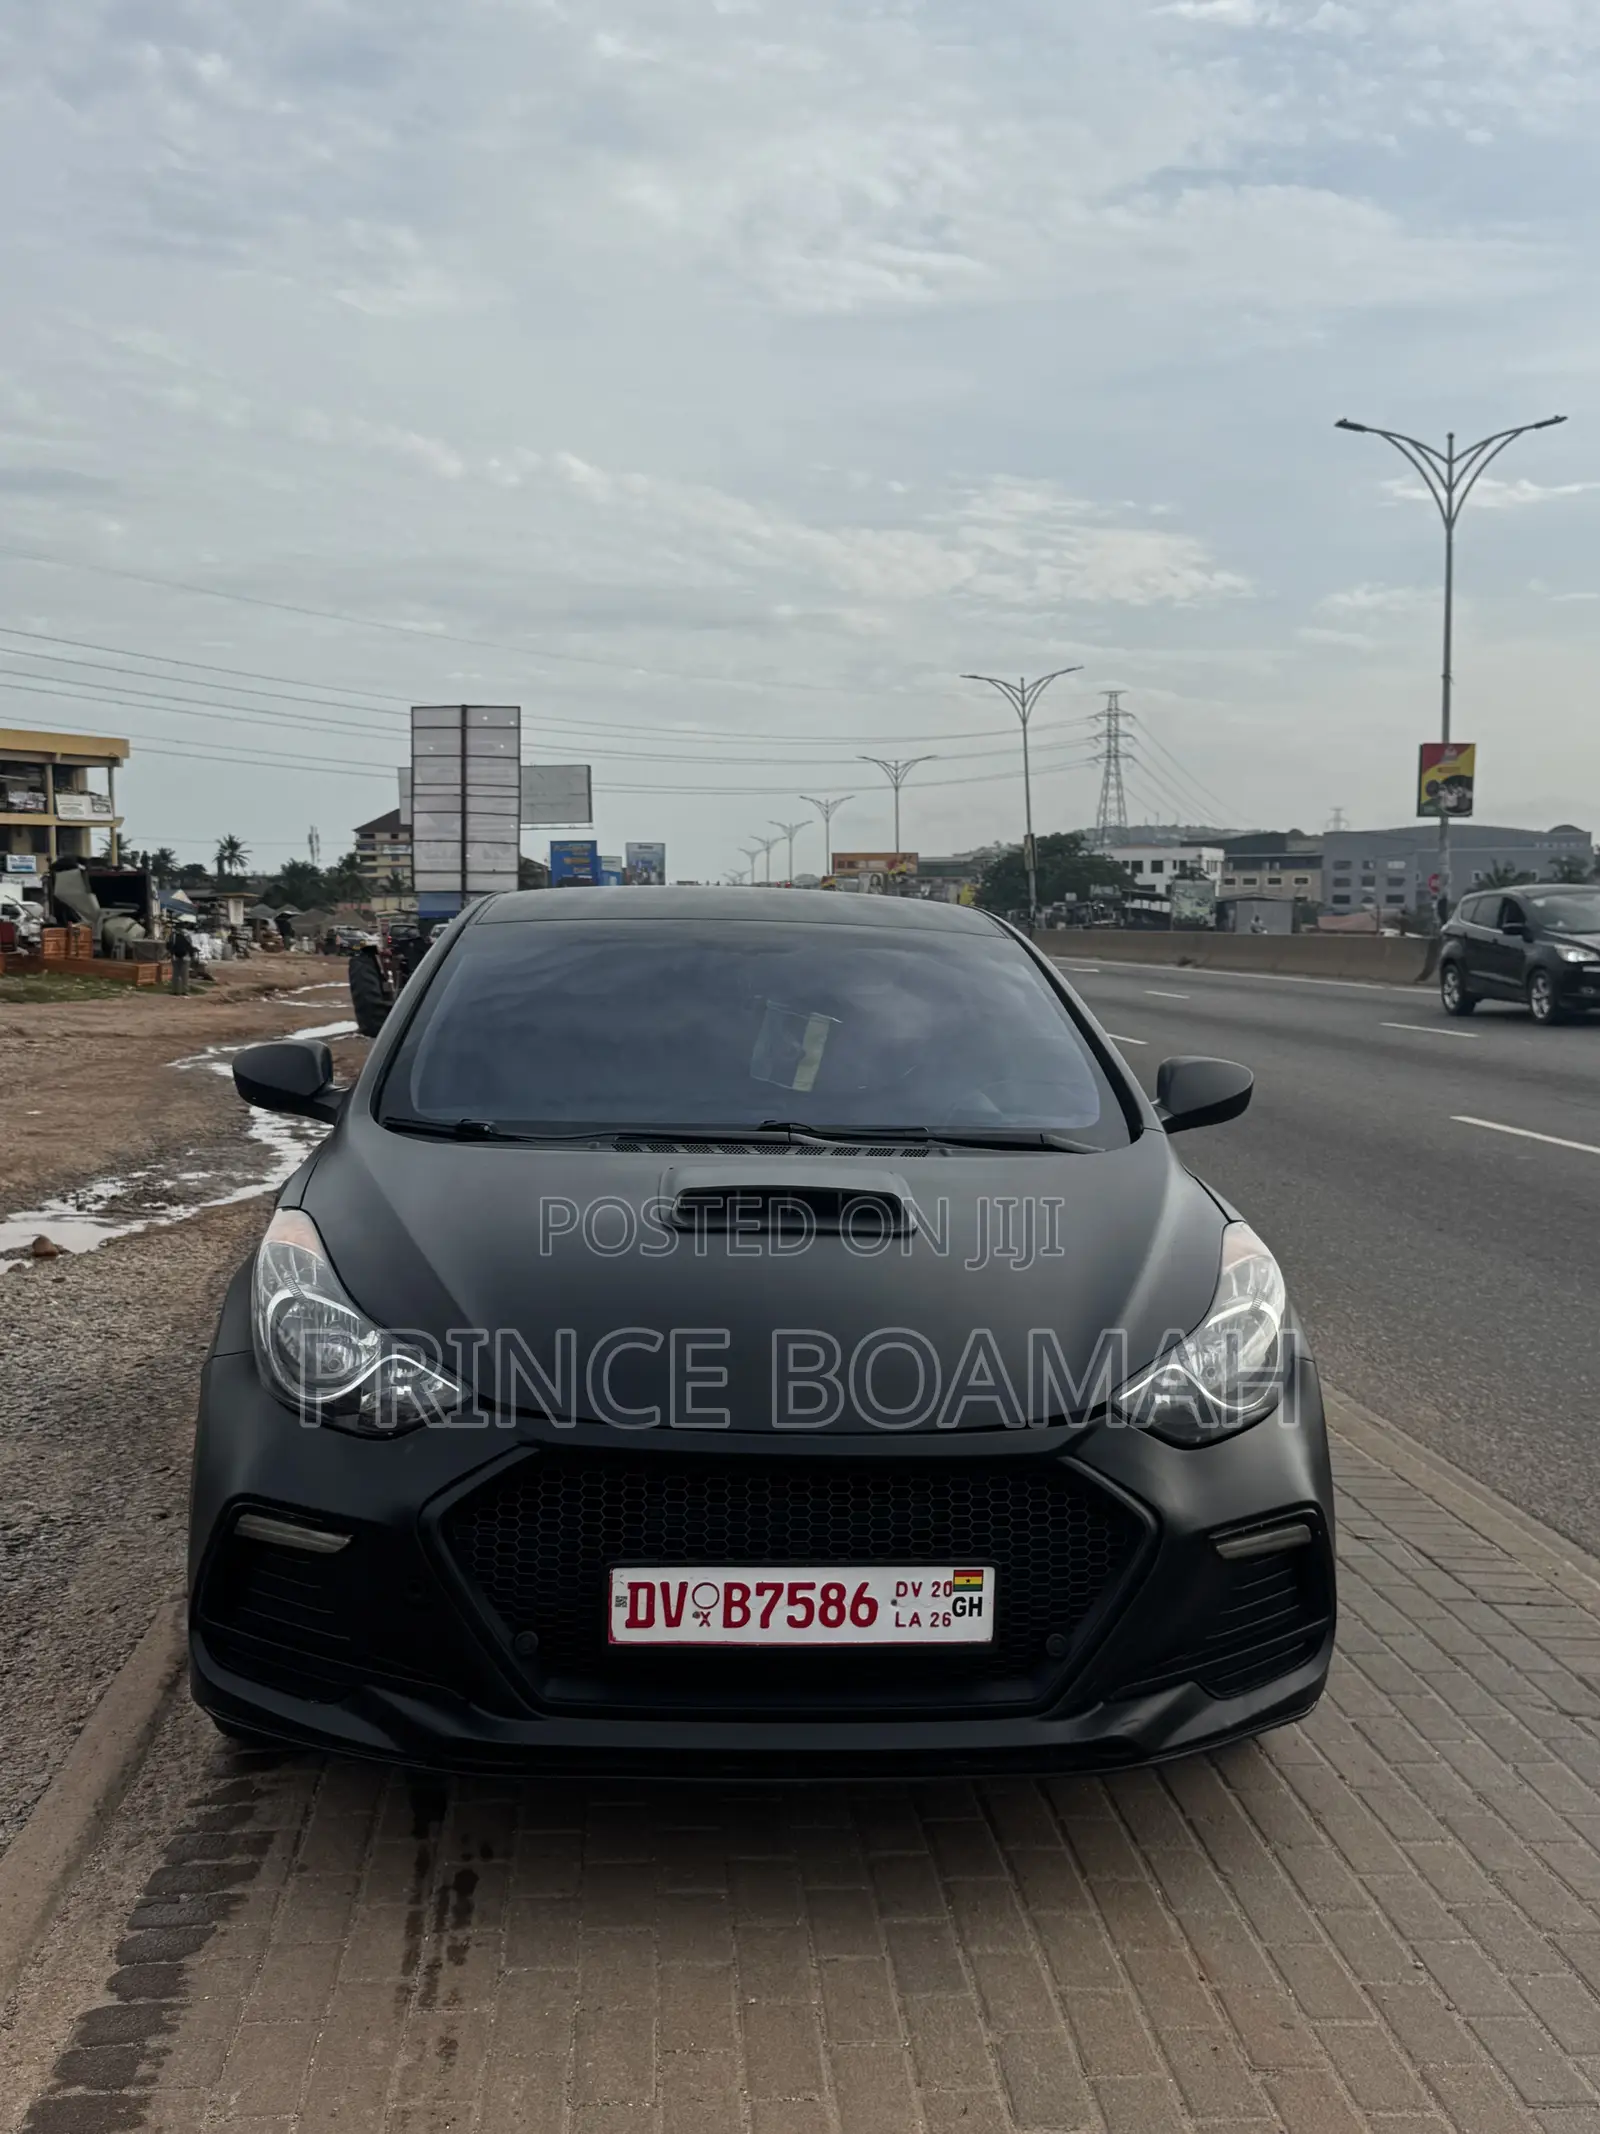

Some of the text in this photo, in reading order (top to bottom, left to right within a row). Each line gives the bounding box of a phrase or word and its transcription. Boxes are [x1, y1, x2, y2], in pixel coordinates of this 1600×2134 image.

[895, 1581, 953, 1598] DV 20
[952, 1596, 983, 1618] GH
[895, 1611, 952, 1628] LA 26
